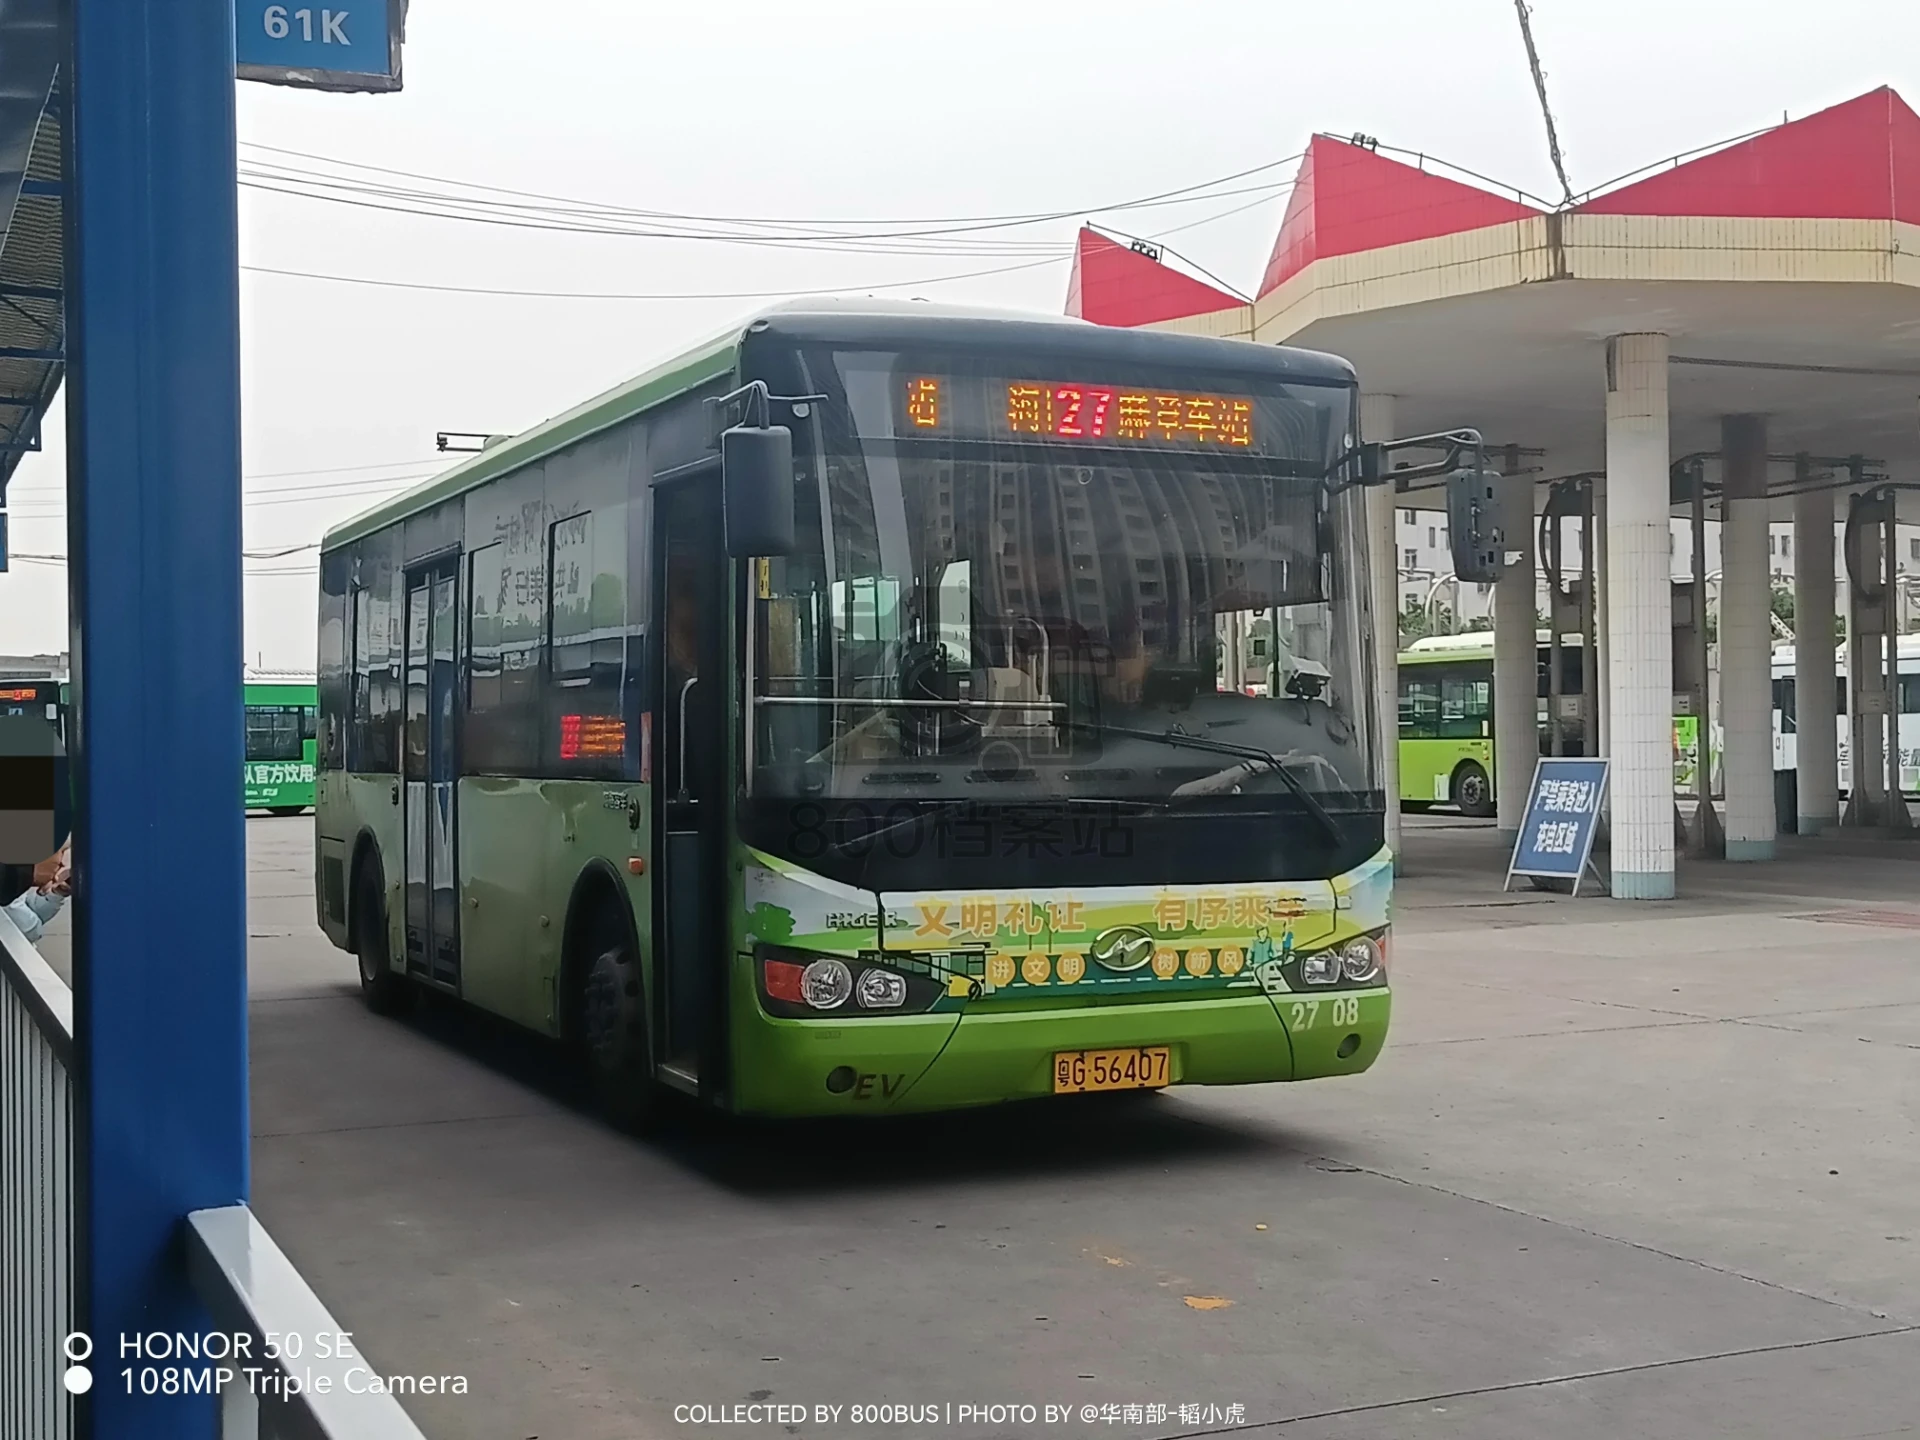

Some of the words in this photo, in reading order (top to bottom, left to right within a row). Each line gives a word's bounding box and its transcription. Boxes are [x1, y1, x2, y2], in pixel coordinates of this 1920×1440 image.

[264, 5, 351, 45] 61K
[1055, 387, 1112, 438] 27
[245, 764, 316, 784] 队官方饮用
[914, 893, 1086, 938] 文明礼让
[1153, 888, 1307, 931] 有序乘车
[1292, 1002, 1321, 1032] 27
[1333, 999, 1359, 1026] 08
[853, 1073, 906, 1100] EV
